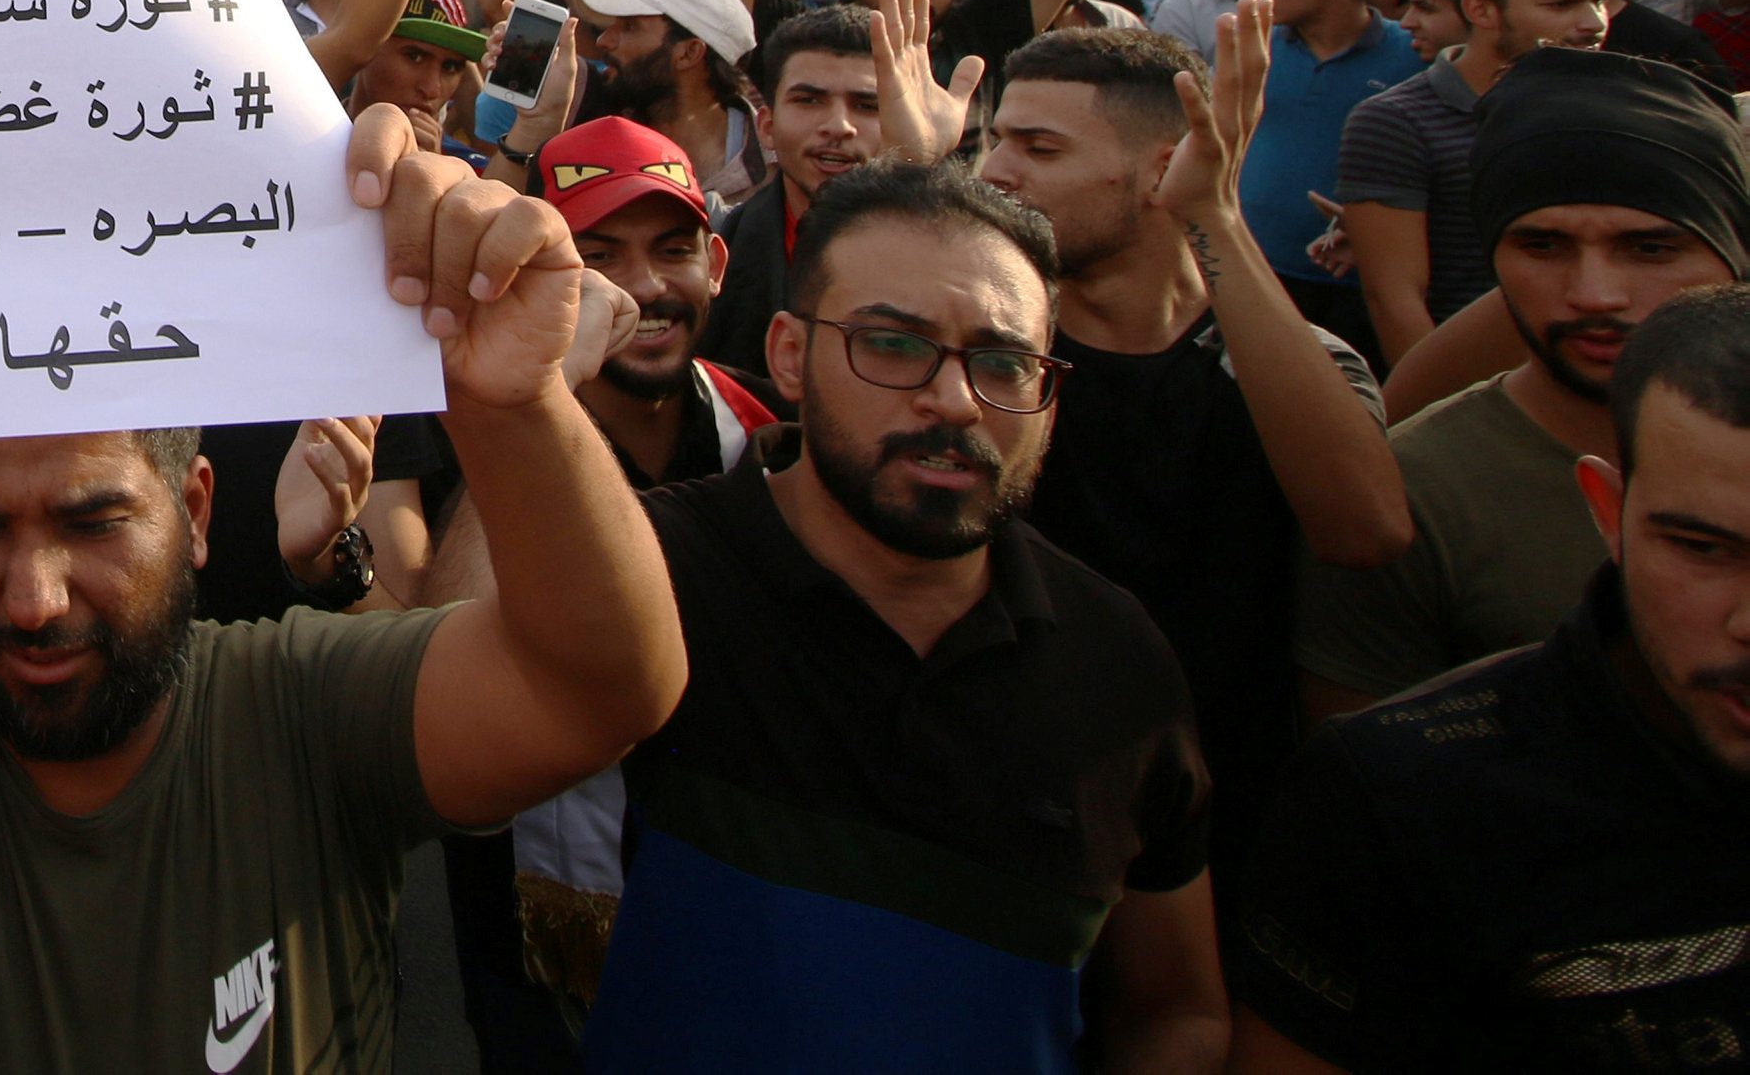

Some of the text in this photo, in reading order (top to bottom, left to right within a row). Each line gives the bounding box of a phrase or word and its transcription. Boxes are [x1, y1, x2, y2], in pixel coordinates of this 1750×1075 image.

[86, 68, 215, 142] ثورة
[92, 178, 295, 255] البصره
[213, 937, 282, 1031] NIKE
